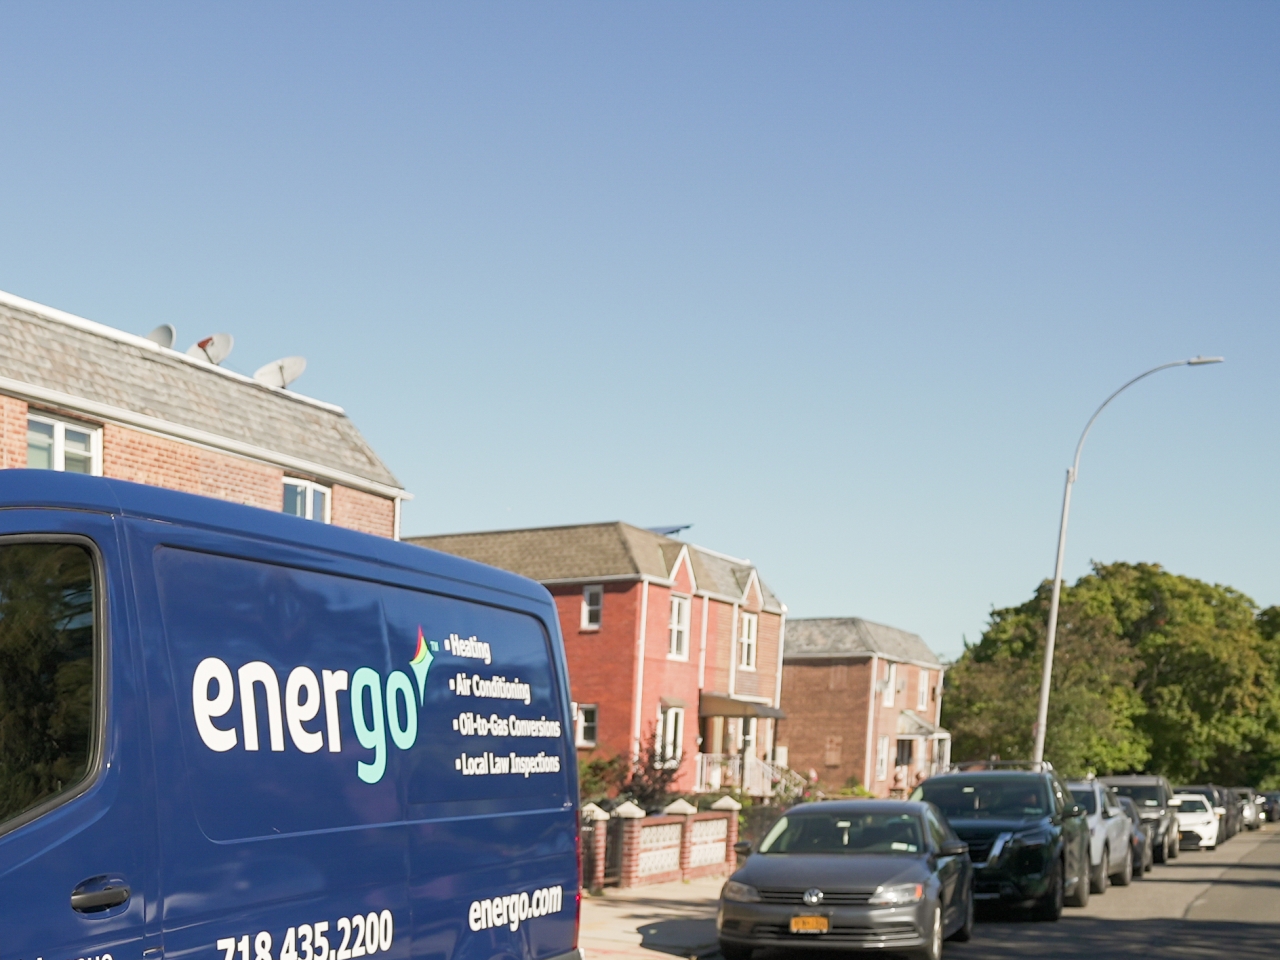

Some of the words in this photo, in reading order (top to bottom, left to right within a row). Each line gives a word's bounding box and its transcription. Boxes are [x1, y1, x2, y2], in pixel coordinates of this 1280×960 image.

[449, 633, 492, 665] Heating
[456, 672, 472, 696] Air
[472, 674, 531, 705] Conditioning
[192, 656, 419, 784] energo
[459, 712, 509, 736] Oil-to-Gas
[509, 715, 561, 738] Conversions
[461, 752, 489, 776] Local
[489, 752, 510, 775] Law
[510, 751, 561, 778] Inspections
[468, 885, 563, 932] energo.com
